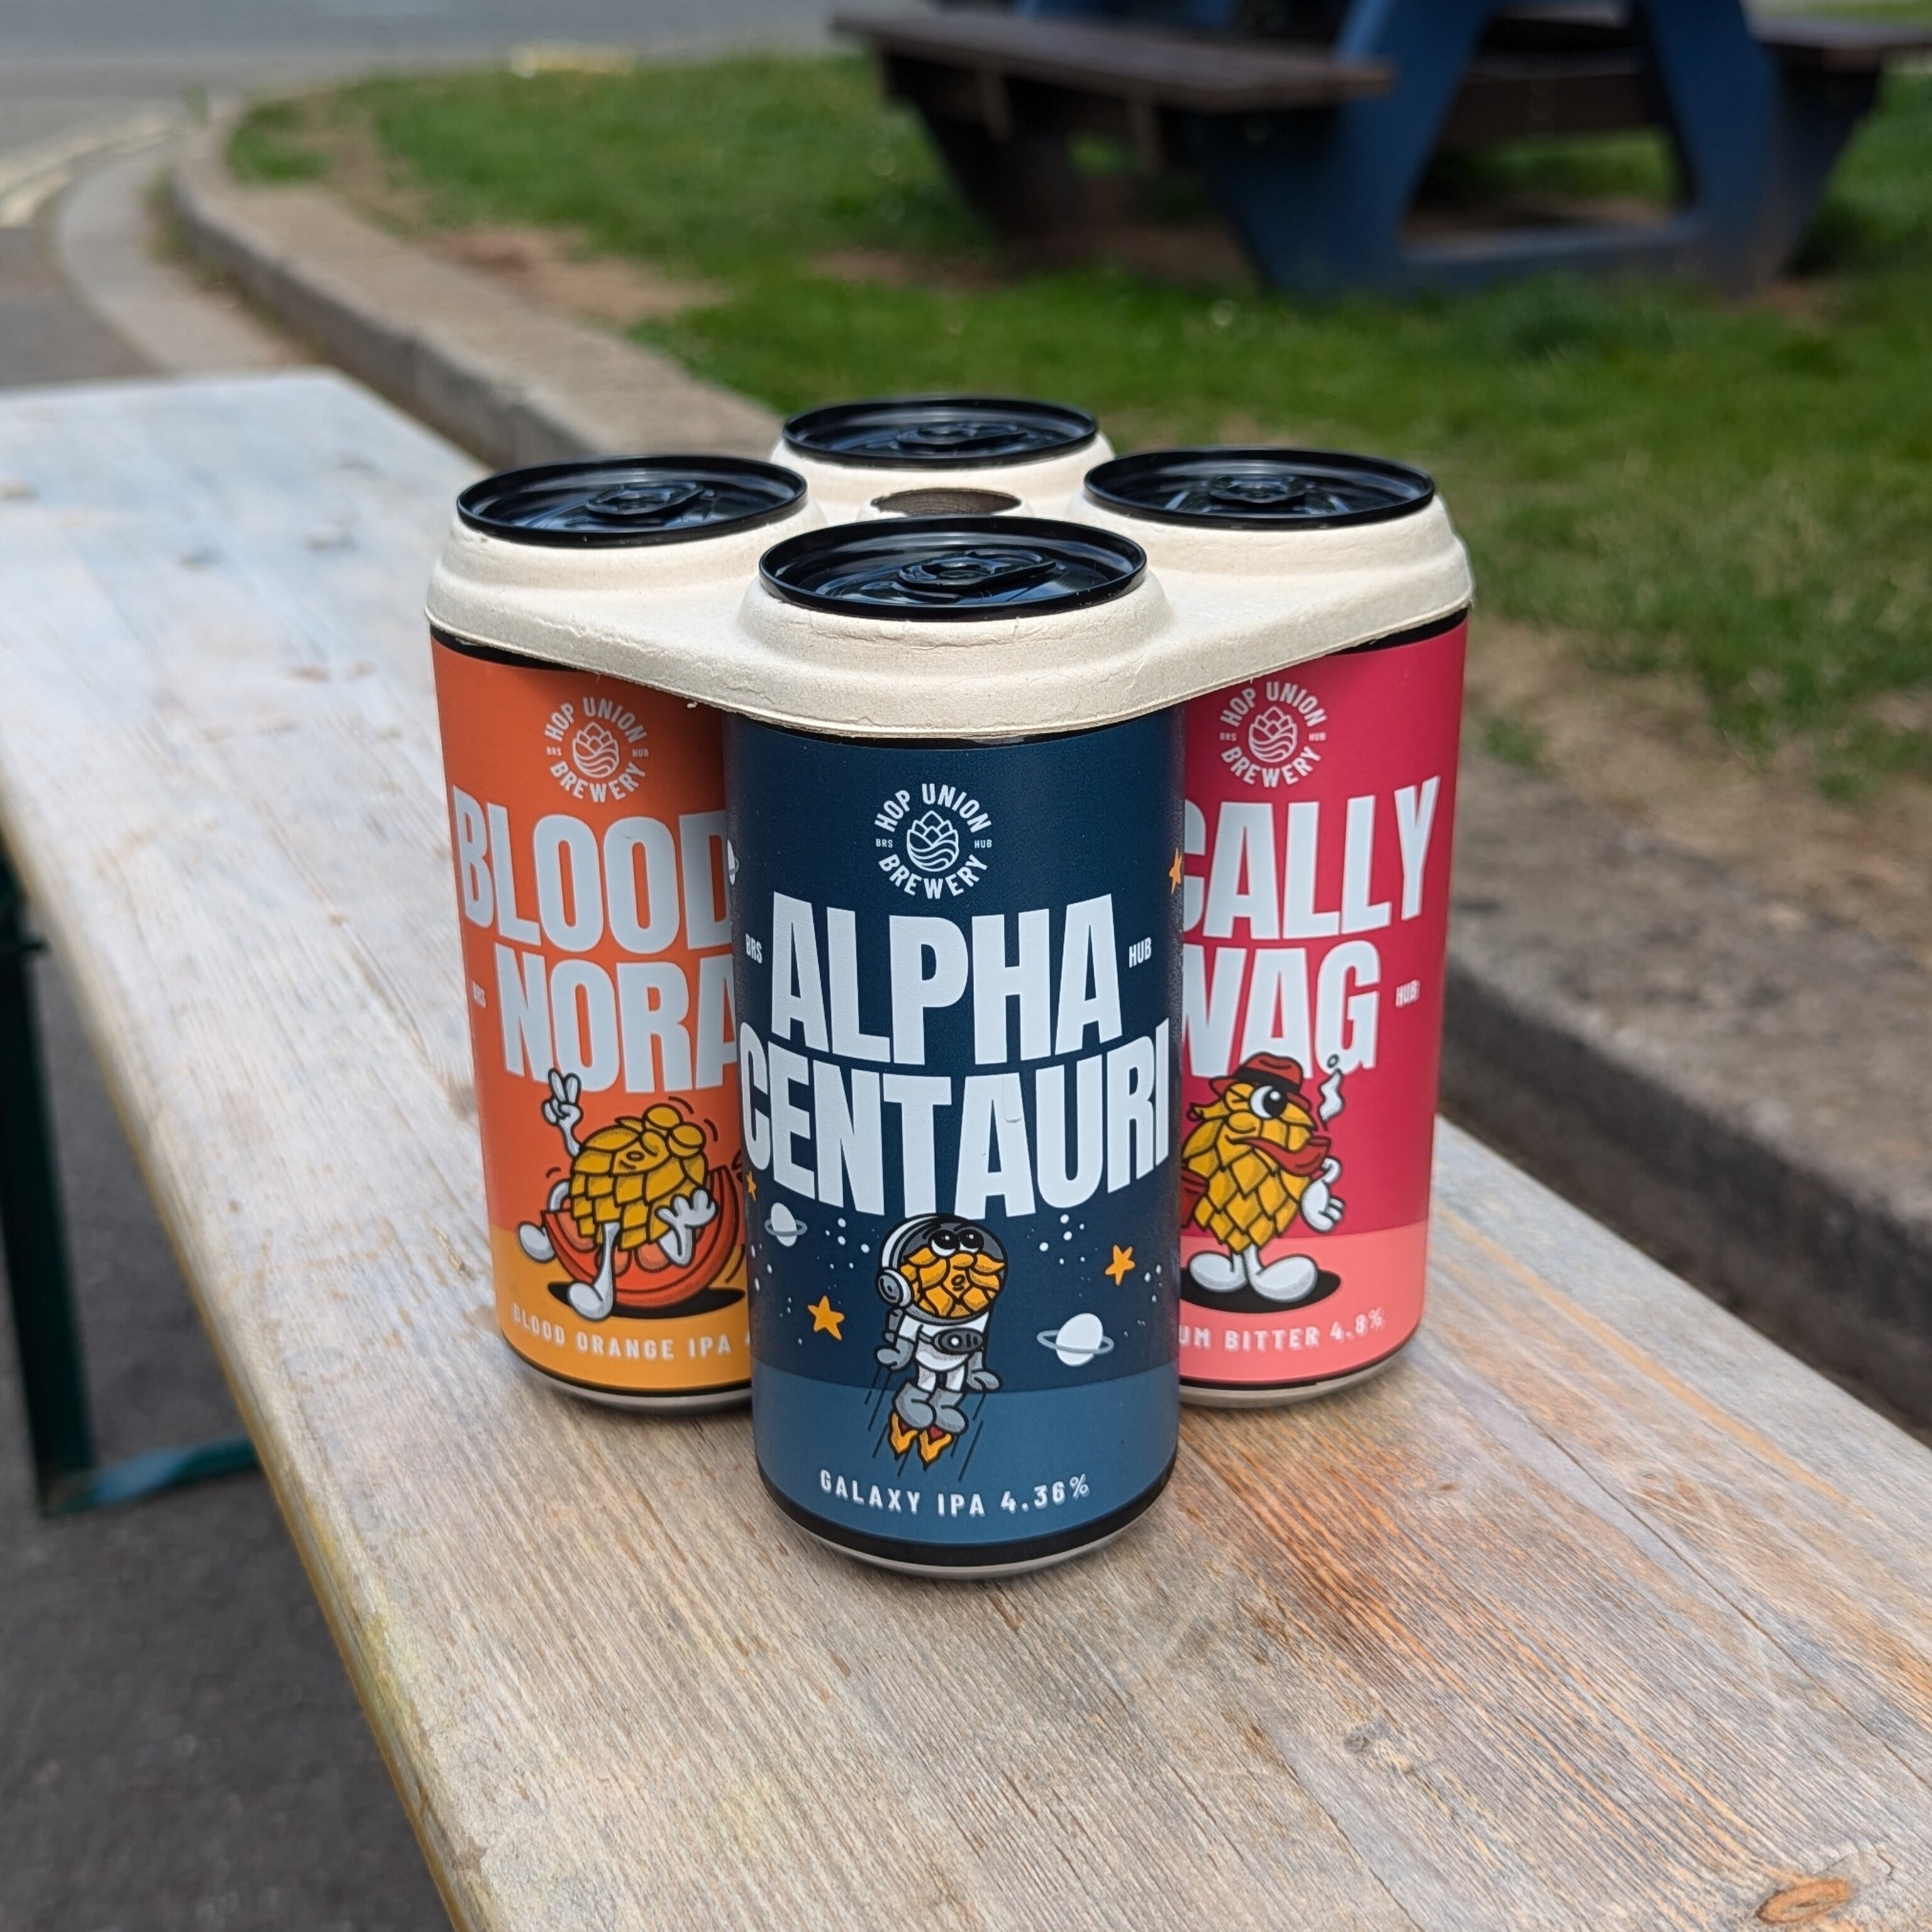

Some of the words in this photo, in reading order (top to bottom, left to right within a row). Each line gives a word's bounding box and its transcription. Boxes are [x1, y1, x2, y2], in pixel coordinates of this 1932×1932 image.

[545, 702, 575, 742] HOP
[583, 697, 647, 743] UNION
[1219, 687, 1256, 727] HOP
[1266, 681, 1327, 727] UNION
[550, 760, 646, 802] BREWERY
[1221, 745, 1321, 787] BREWERY
[874, 790, 911, 833] HOP
[921, 783, 992, 833] UNION
[875, 838, 893, 848] BRS
[974, 839, 992, 849] HUB
[453, 784, 731, 954] BLOOD
[879, 854, 988, 899] BREWERY
[745, 933, 763, 964] BRS
[1129, 937, 1152, 969] HUB
[772, 891, 1123, 1065] ALPHA
[494, 942, 737, 1093] NORA
[740, 1018, 1169, 1220] CENTAURI
[513, 1302, 566, 1346] BLOOD
[576, 1330, 674, 1360] ORANGE
[688, 1333, 731, 1359] IPA
[1224, 1326, 1320, 1352] BITTER
[1330, 1306, 1385, 1343] 4.8%
[819, 1469, 921, 1514] GALAXY
[938, 1493, 985, 1517] IPA
[1001, 1473, 1090, 1514] 4.36%
